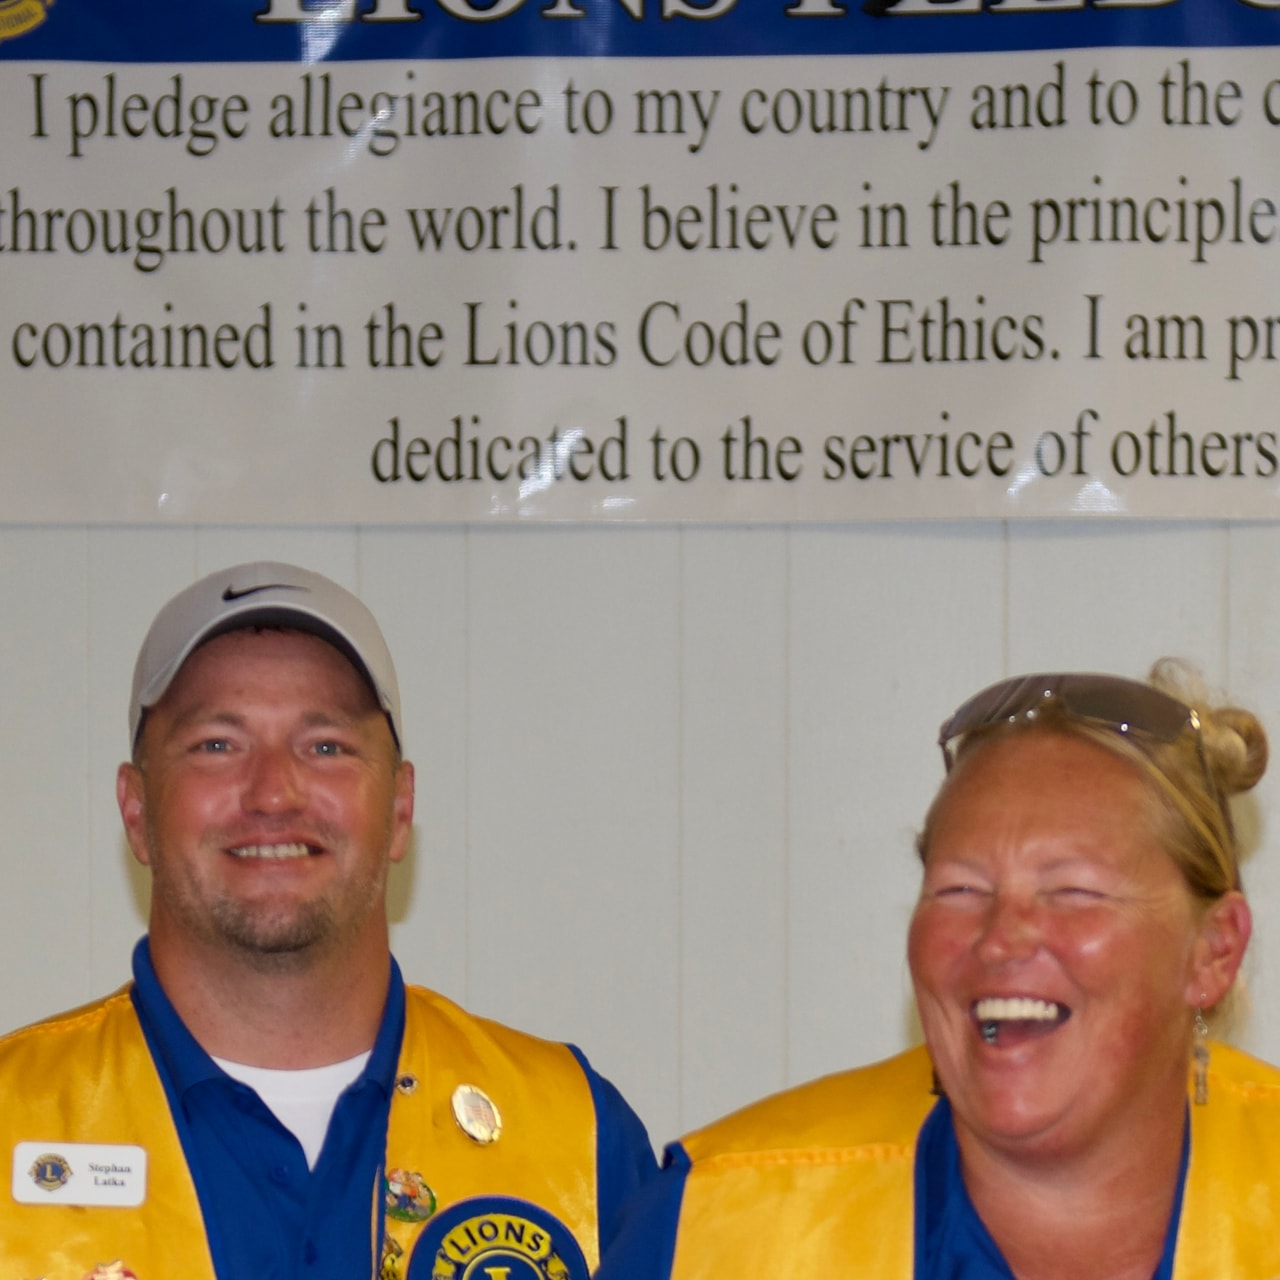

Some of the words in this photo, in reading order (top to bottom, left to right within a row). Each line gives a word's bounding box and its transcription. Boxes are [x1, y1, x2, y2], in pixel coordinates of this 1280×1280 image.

[32, 74, 49, 138] I
[67, 76, 249, 158] pledge
[269, 73, 541, 157] allegiance
[563, 84, 614, 135] to
[635, 90, 720, 154] my
[741, 83, 949, 151] country
[971, 63, 1067, 130] and
[1087, 74, 1139, 126] to
[1159, 61, 1242, 127] the
[305, 187, 387, 254] the
[406, 184, 576, 252] world.
[600, 187, 618, 250] I
[639, 184, 838, 251] believe
[859, 182, 909, 248] in
[929, 181, 1011, 248] the
[12, 302, 275, 370] contained
[296, 303, 346, 368] in
[365, 302, 444, 368] the
[464, 300, 617, 367] Lions
[638, 300, 782, 367] Code
[802, 298, 866, 366] of
[877, 295, 1060, 364] Ethics.
[1085, 295, 1102, 359] I
[1124, 314, 1207, 360] am
[371, 415, 630, 483] dedicated
[650, 429, 701, 482] to
[720, 415, 803, 482] the
[824, 411, 1014, 481] service
[1036, 409, 1099, 477] of
[450, 1219, 545, 1255] LIONS
